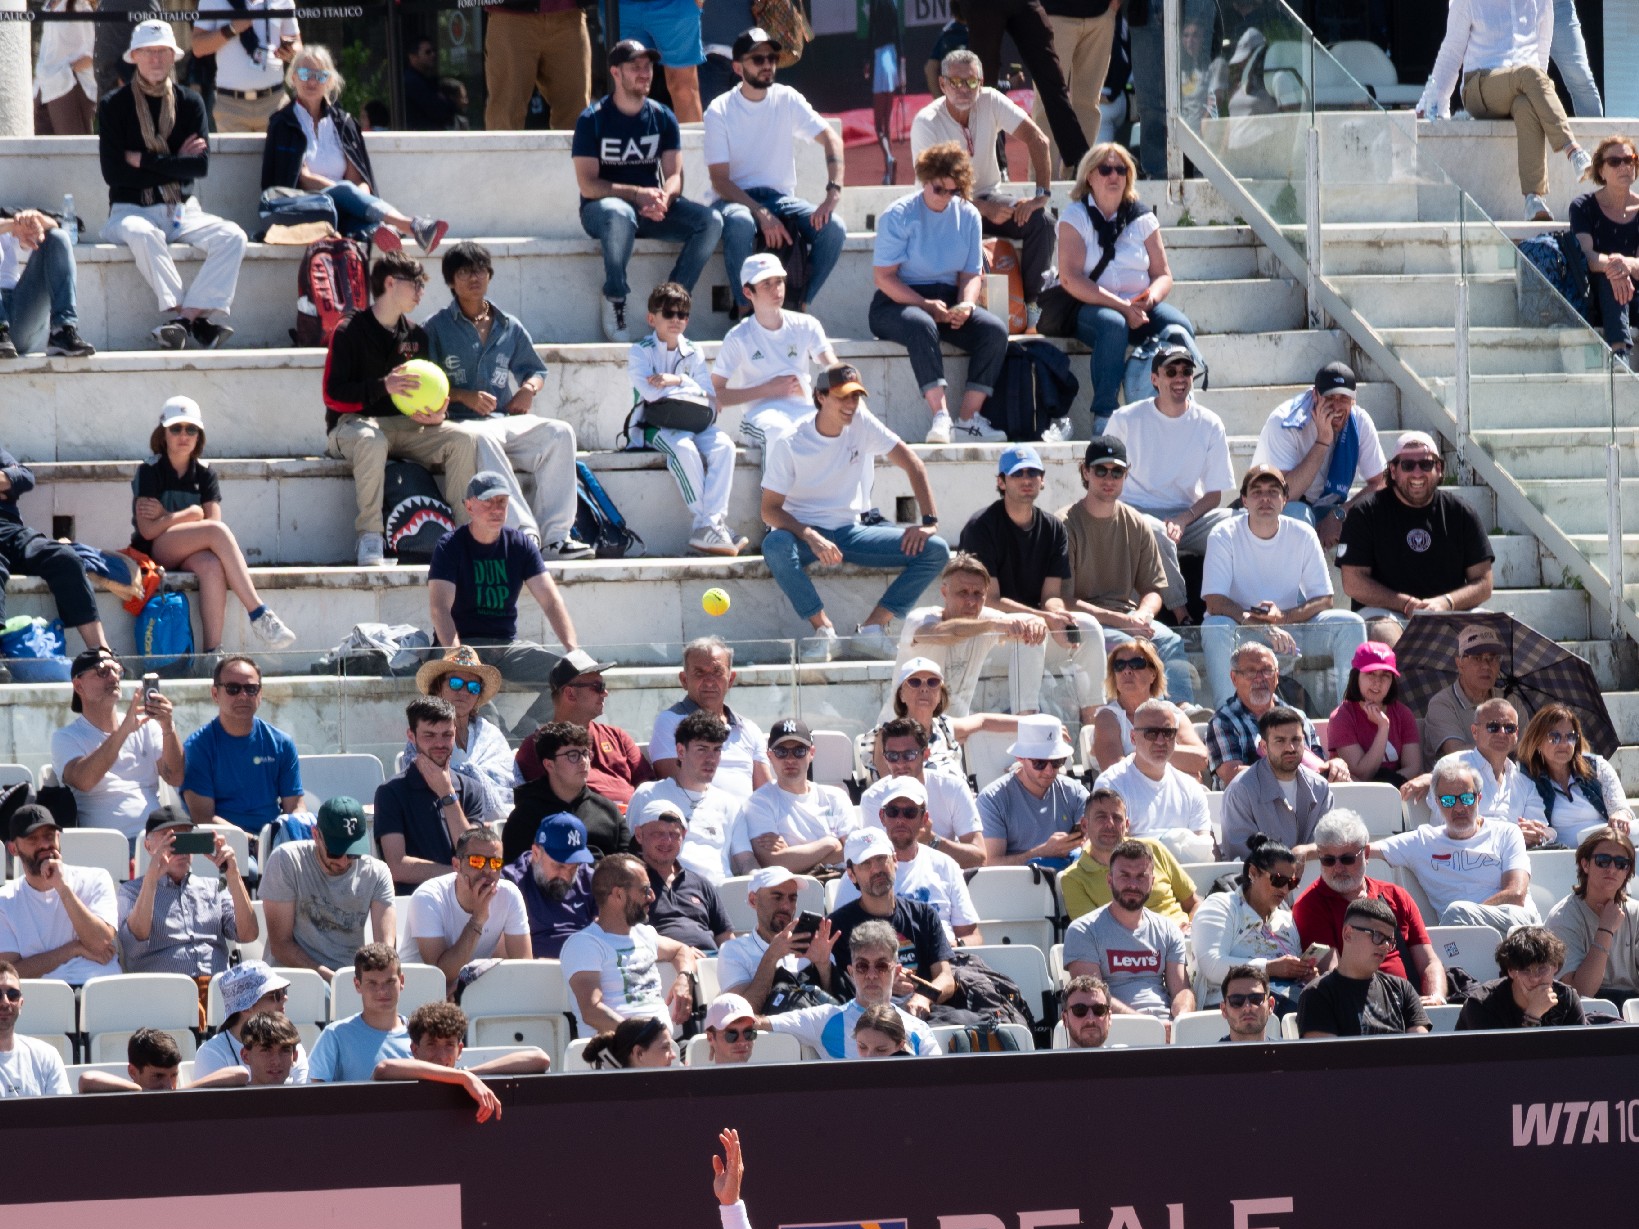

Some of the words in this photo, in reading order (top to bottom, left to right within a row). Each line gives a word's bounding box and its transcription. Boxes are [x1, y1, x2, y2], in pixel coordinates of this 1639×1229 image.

[322, 5, 363, 18] ITALICO
[601, 134, 660, 161] EA7
[473, 559, 508, 586] DUN
[567, 829, 581, 846] NY
[1431, 849, 1501, 872] FILA
[1512, 1100, 1609, 1147] WTA
